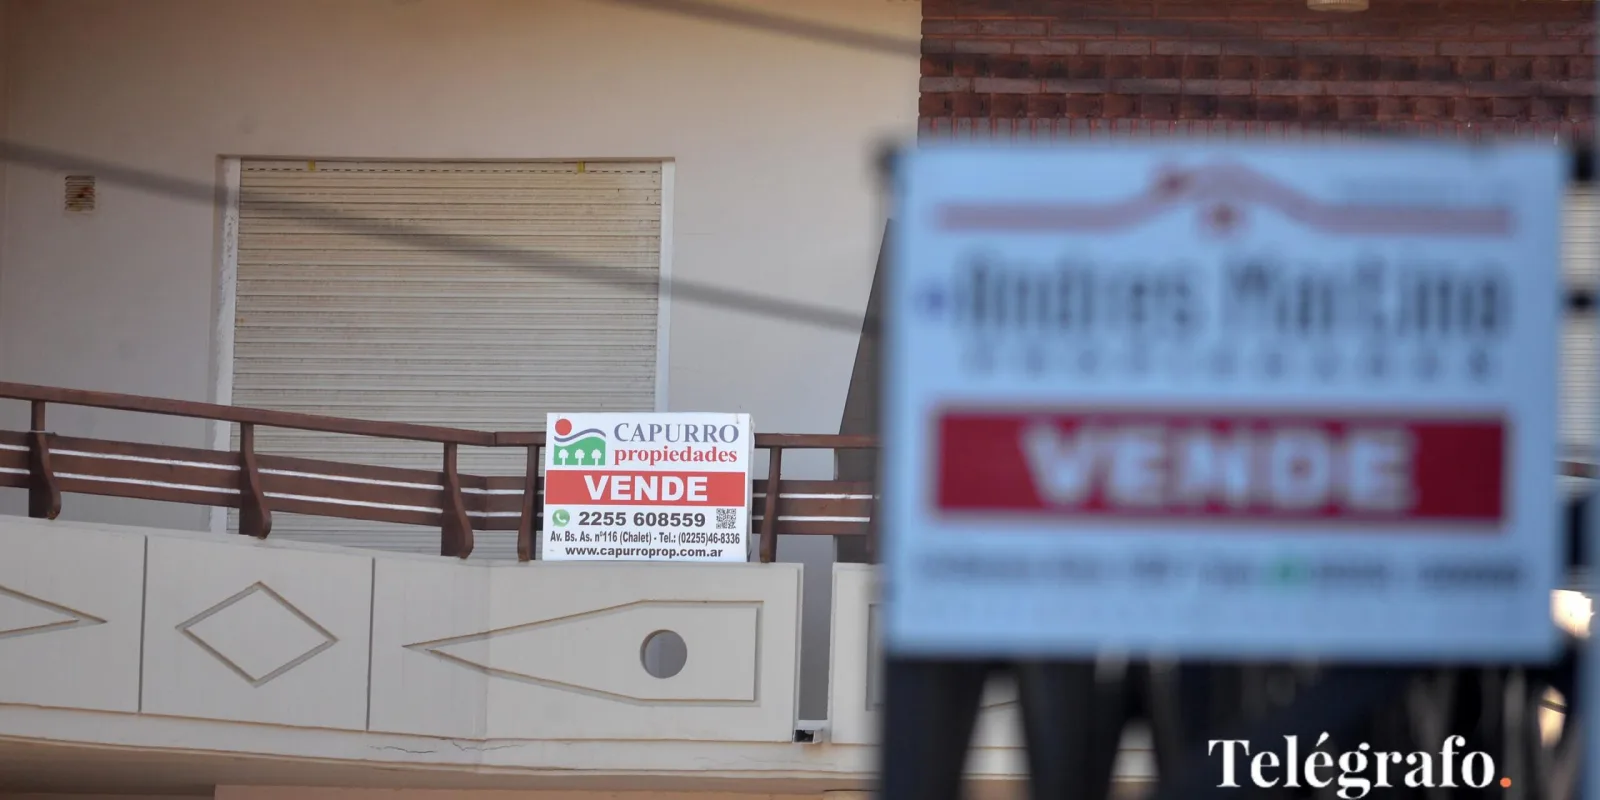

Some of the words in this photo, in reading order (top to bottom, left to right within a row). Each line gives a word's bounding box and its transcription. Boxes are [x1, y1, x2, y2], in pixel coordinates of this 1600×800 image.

[613, 422, 739, 444] CAPURRO
[613, 445, 738, 466] propiedades
[1021, 420, 1420, 514] VENDE
[583, 474, 708, 502] VENDE
[578, 511, 627, 526] 2255
[633, 511, 706, 528] 608559
[550, 530, 562, 542] Av.
[564, 531, 577, 543] Bs.
[579, 531, 592, 543] As.
[619, 531, 652, 546] (Chalet)
[659, 532, 676, 544] Tel.:
[678, 533, 740, 547] (02255)46-8336
[565, 545, 723, 559] www.capurroprop.com.ar
